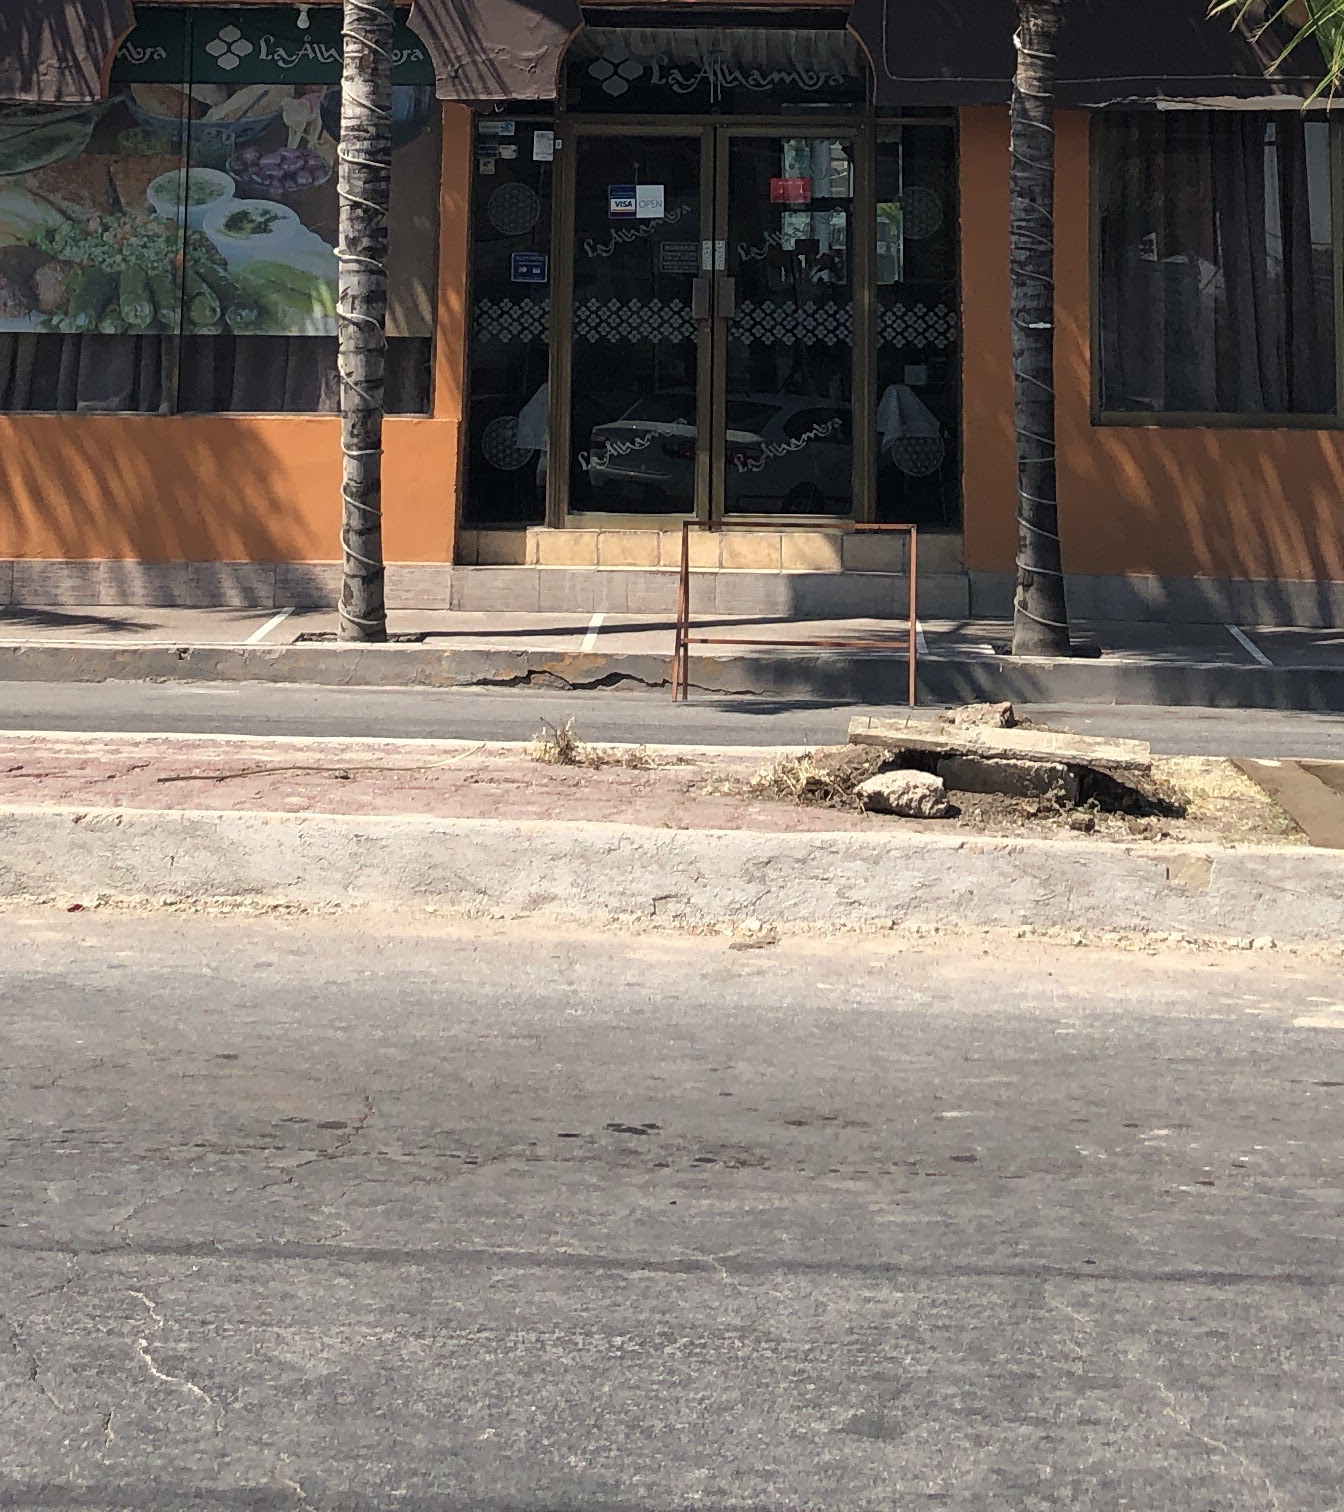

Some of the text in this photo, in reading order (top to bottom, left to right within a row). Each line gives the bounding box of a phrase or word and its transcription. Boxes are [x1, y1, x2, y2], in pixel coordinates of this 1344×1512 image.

[259, 34, 296, 61] La
[650, 51, 844, 93] La Alhambra
[614, 200, 632, 208] VISA
[638, 199, 663, 208] OPEN
